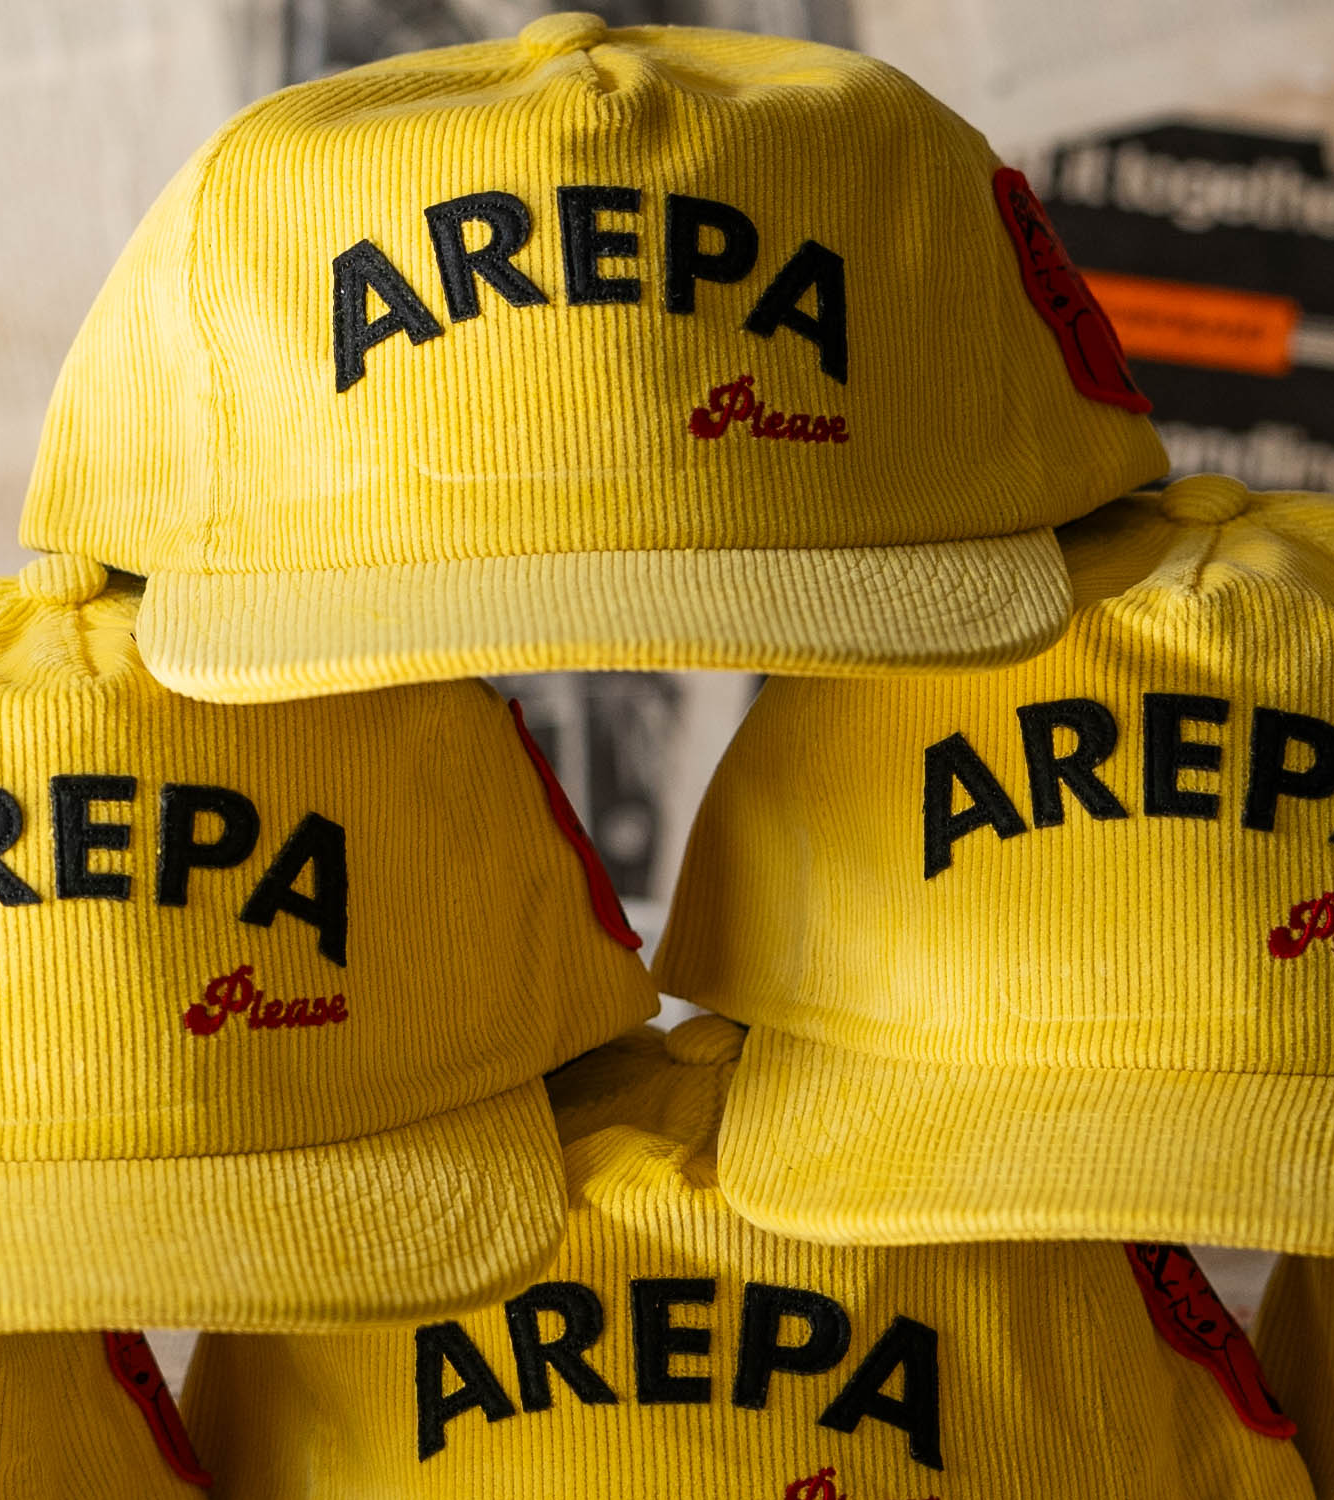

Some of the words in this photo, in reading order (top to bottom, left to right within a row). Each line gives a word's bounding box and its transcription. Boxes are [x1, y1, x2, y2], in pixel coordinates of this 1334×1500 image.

[333, 185, 849, 393] AREPA
[690, 375, 850, 444] Please
[184, 965, 348, 1035] Please
[414, 1278, 945, 1471] AREPA
